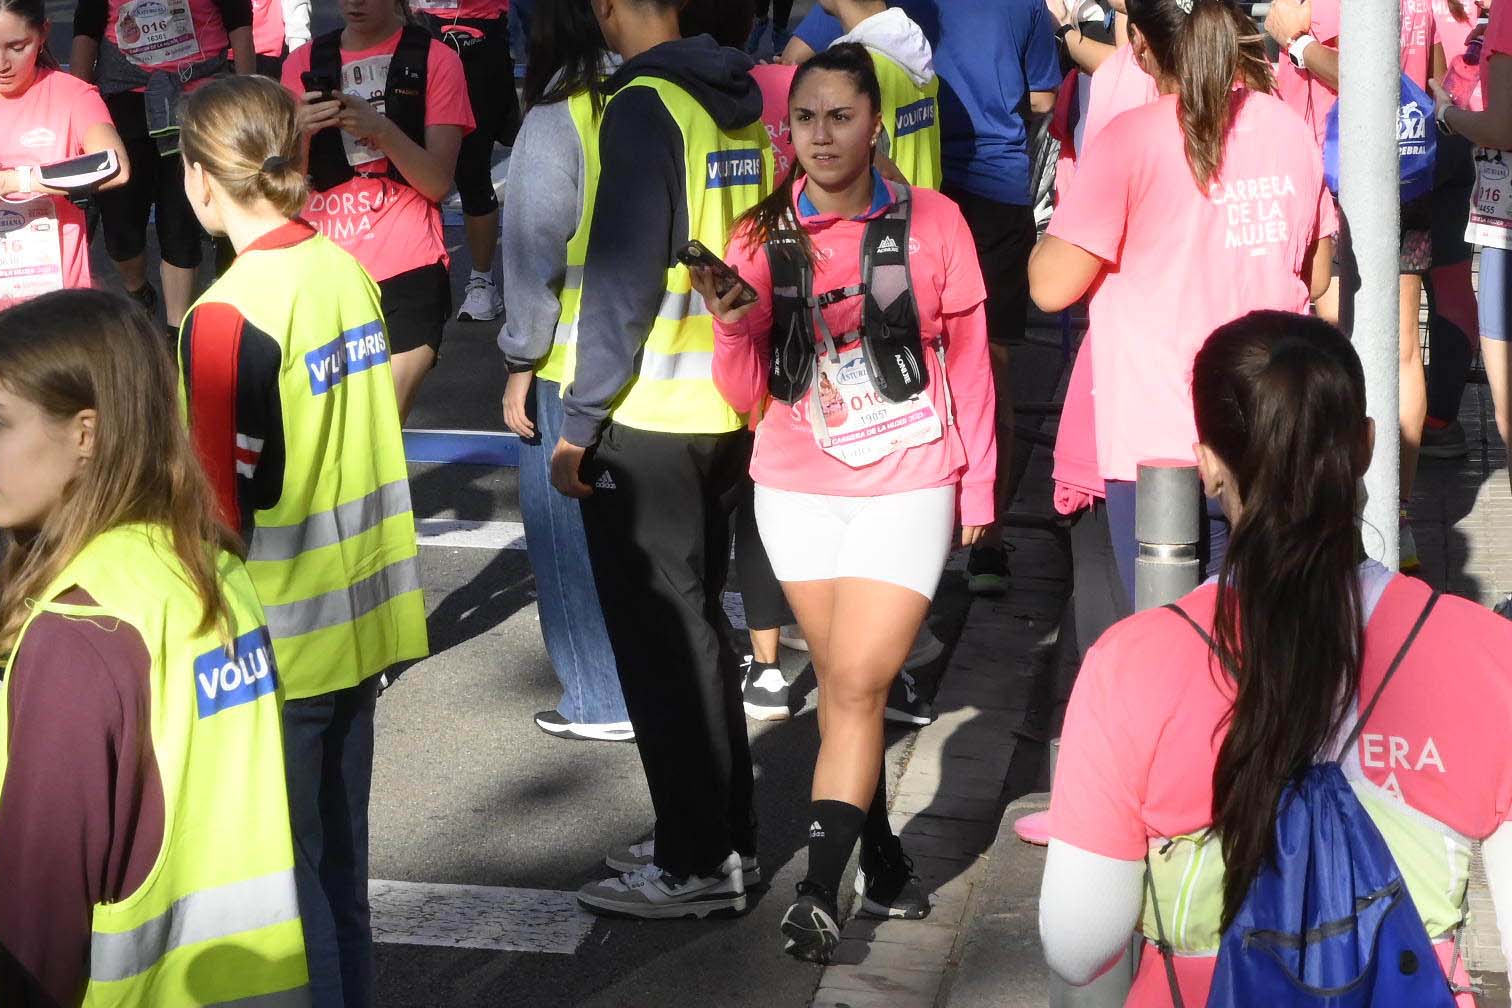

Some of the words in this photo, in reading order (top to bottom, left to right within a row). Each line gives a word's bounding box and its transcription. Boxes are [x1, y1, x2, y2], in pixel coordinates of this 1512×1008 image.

[141, 20, 167, 34] 016
[1209, 176, 1296, 206] CARRERA
[1227, 202, 1253, 225] DE
[1257, 200, 1284, 222] LA
[1225, 220, 1289, 250] MUJER
[894, 353, 912, 385] AONIJIE
